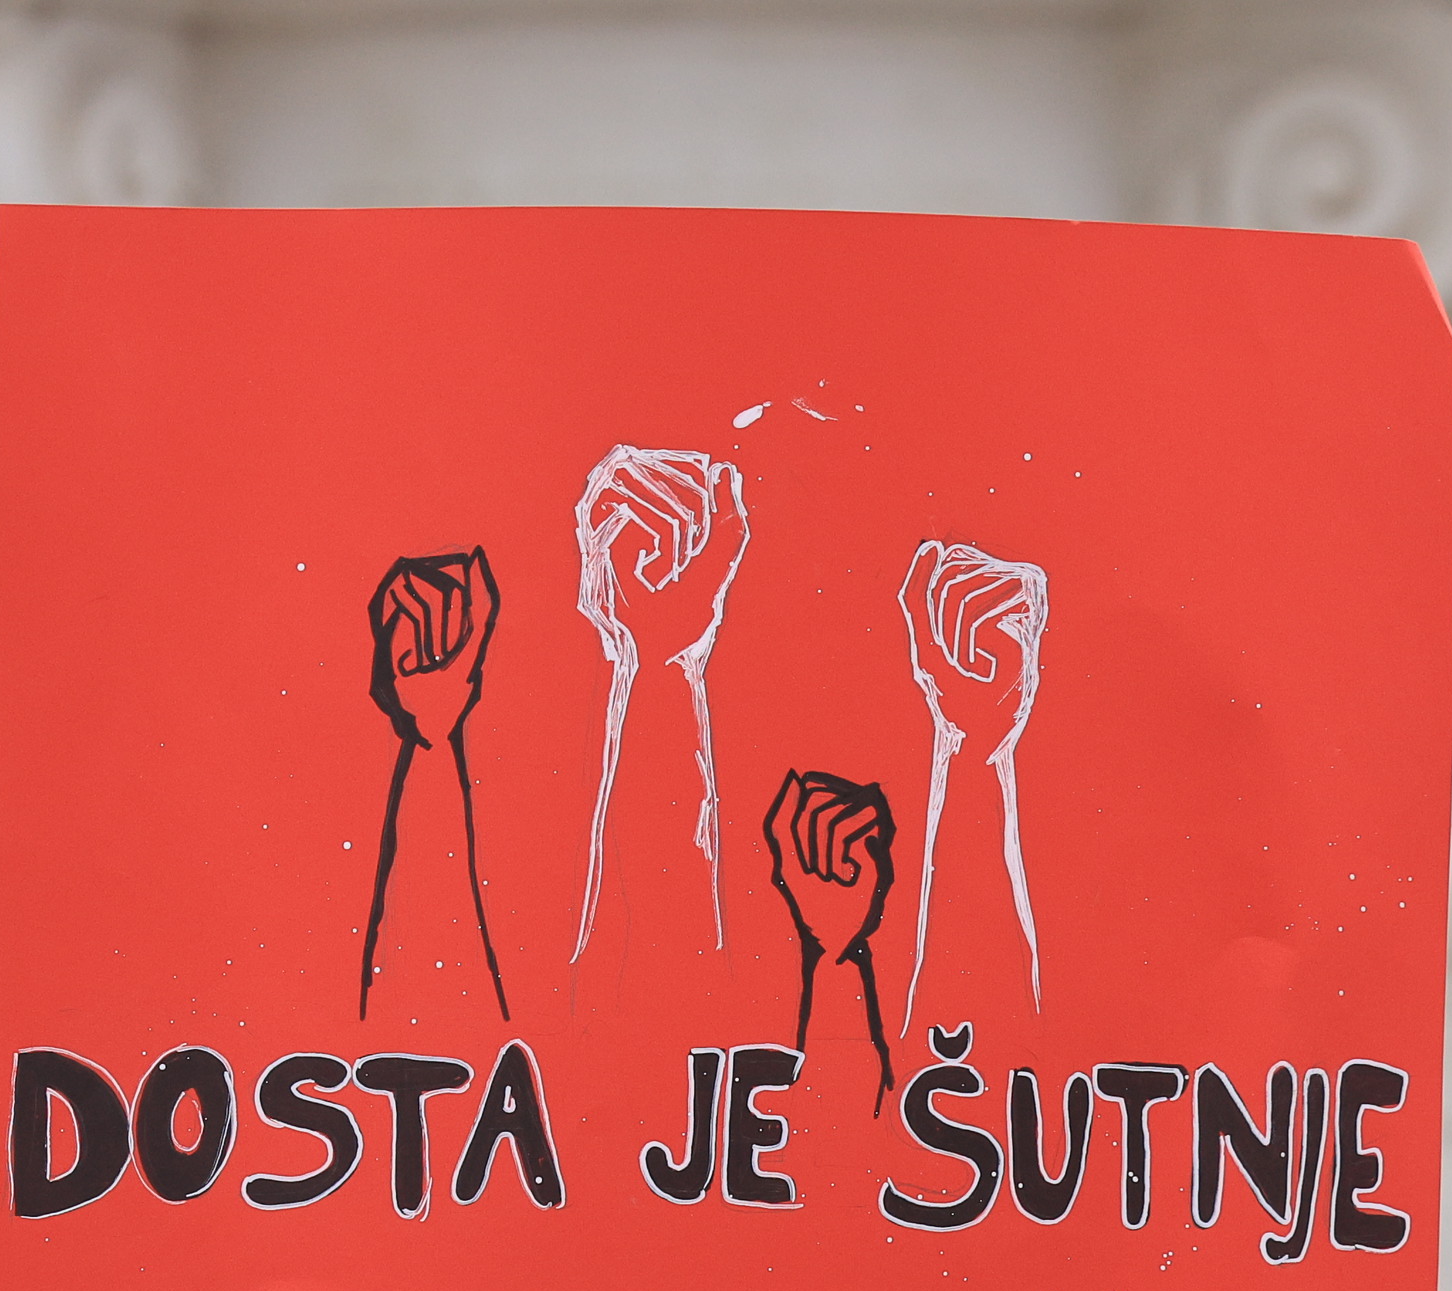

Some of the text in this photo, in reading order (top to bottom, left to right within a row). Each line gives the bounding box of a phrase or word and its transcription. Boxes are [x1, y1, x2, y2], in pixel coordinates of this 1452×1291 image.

[6, 1021, 1413, 1267] DOSTA JE ŠUTNJE
